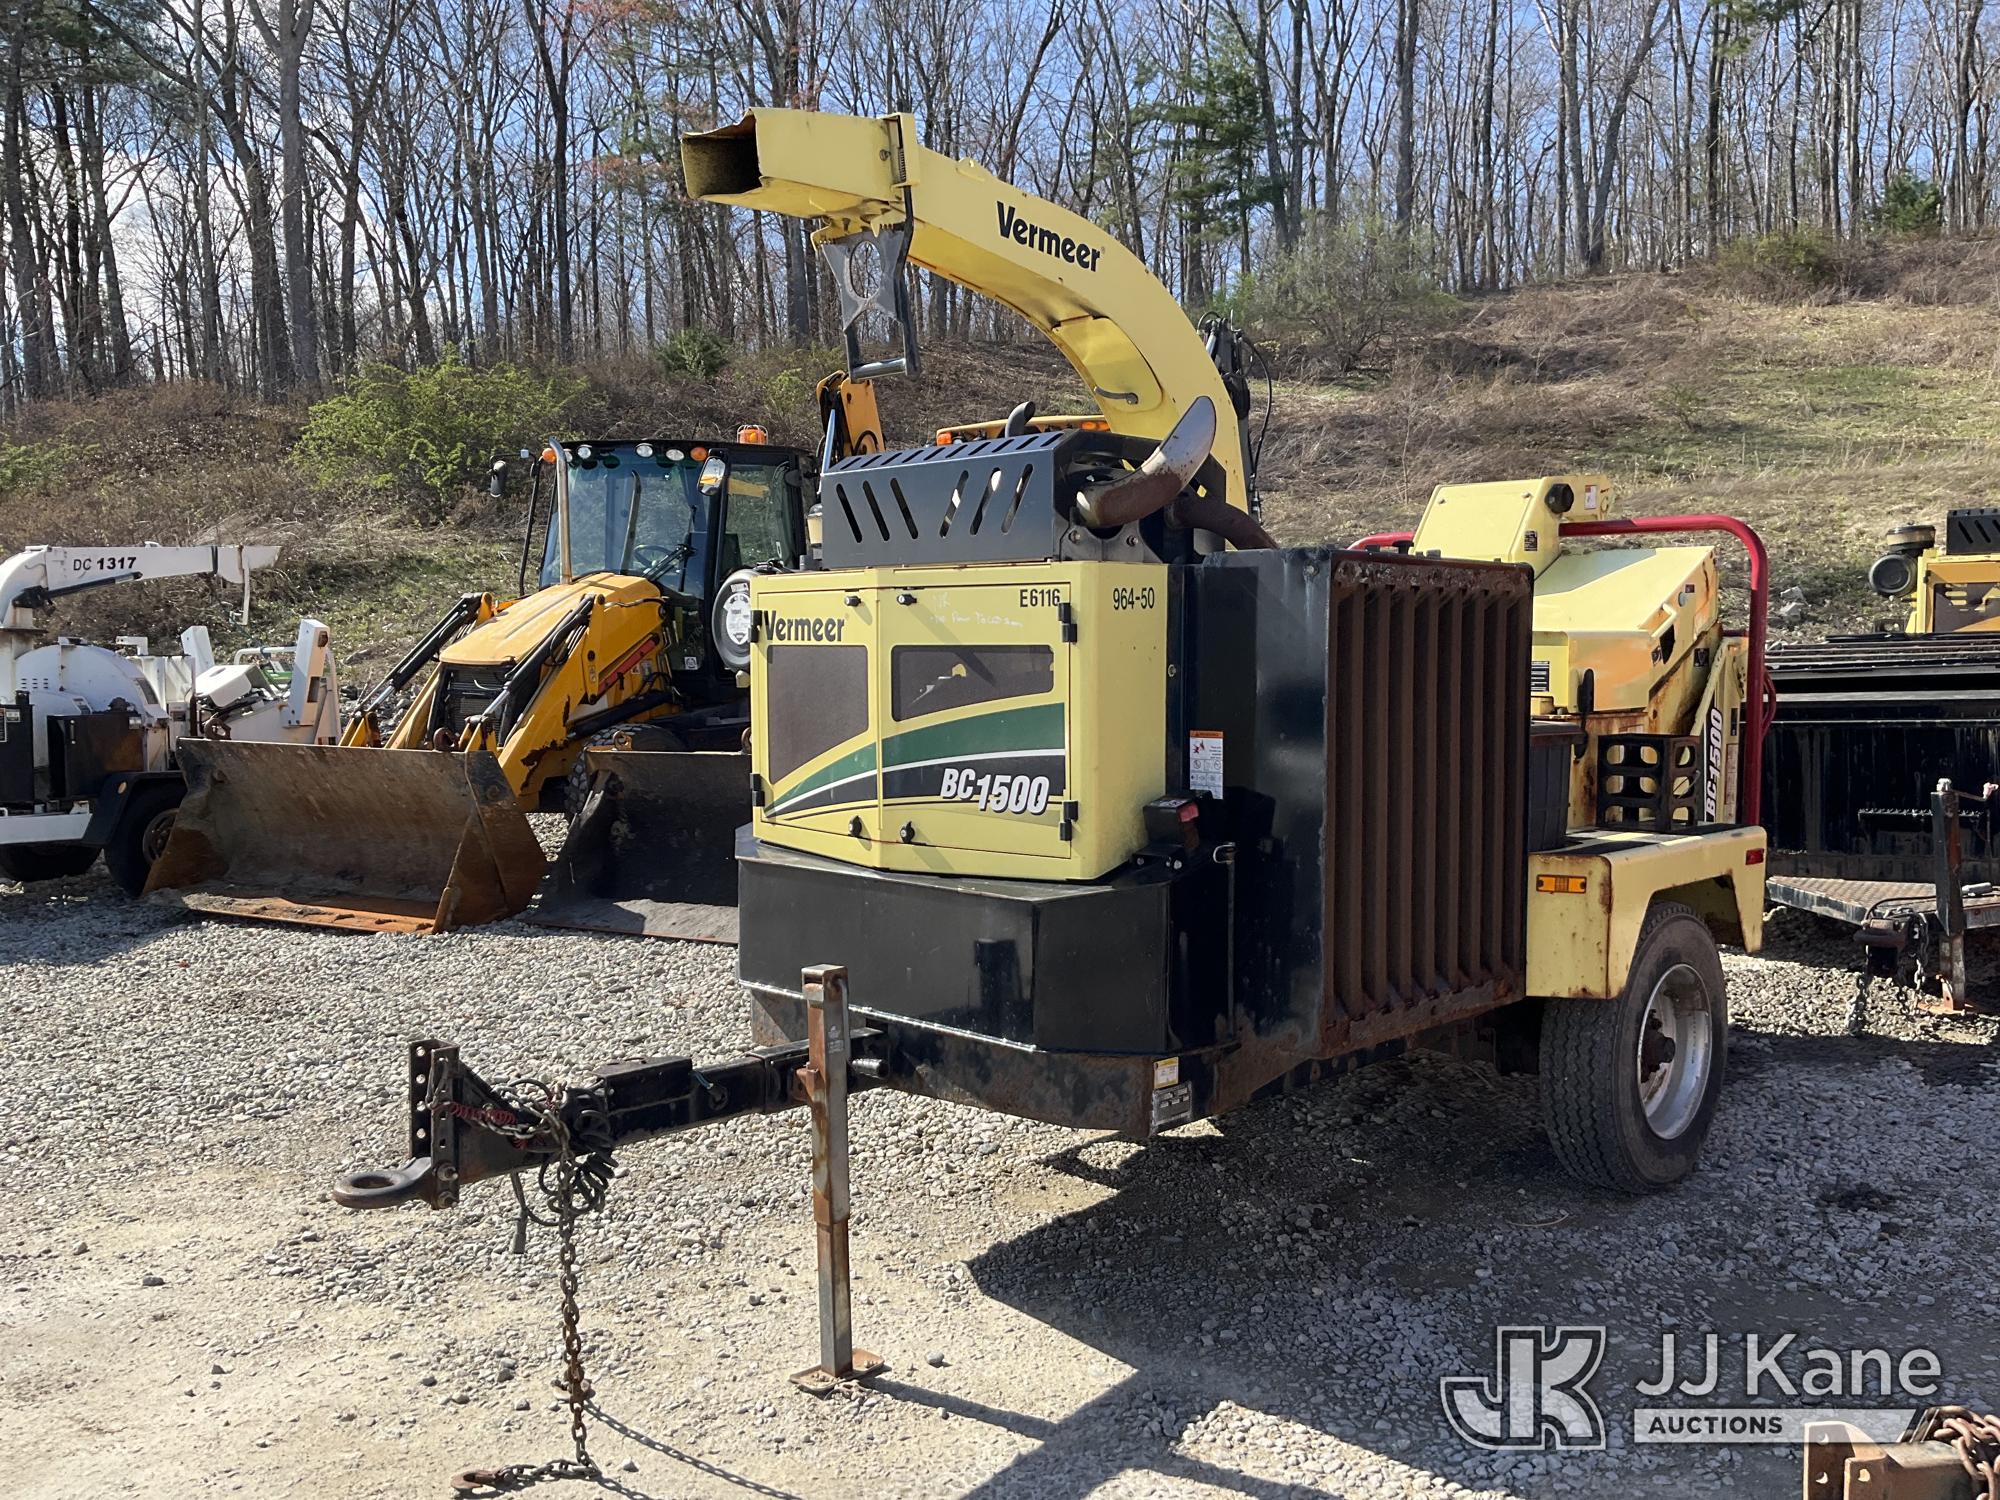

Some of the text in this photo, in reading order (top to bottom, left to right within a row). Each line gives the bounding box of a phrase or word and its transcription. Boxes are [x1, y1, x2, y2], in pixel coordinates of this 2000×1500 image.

[997, 200, 1101, 272] Vermeer
[73, 556, 137, 571] DC 1317
[1019, 588, 1061, 608] E6116
[1112, 586, 1155, 611] 964-50
[763, 609, 845, 642] Vermeer
[940, 767, 1050, 815] BC1500
